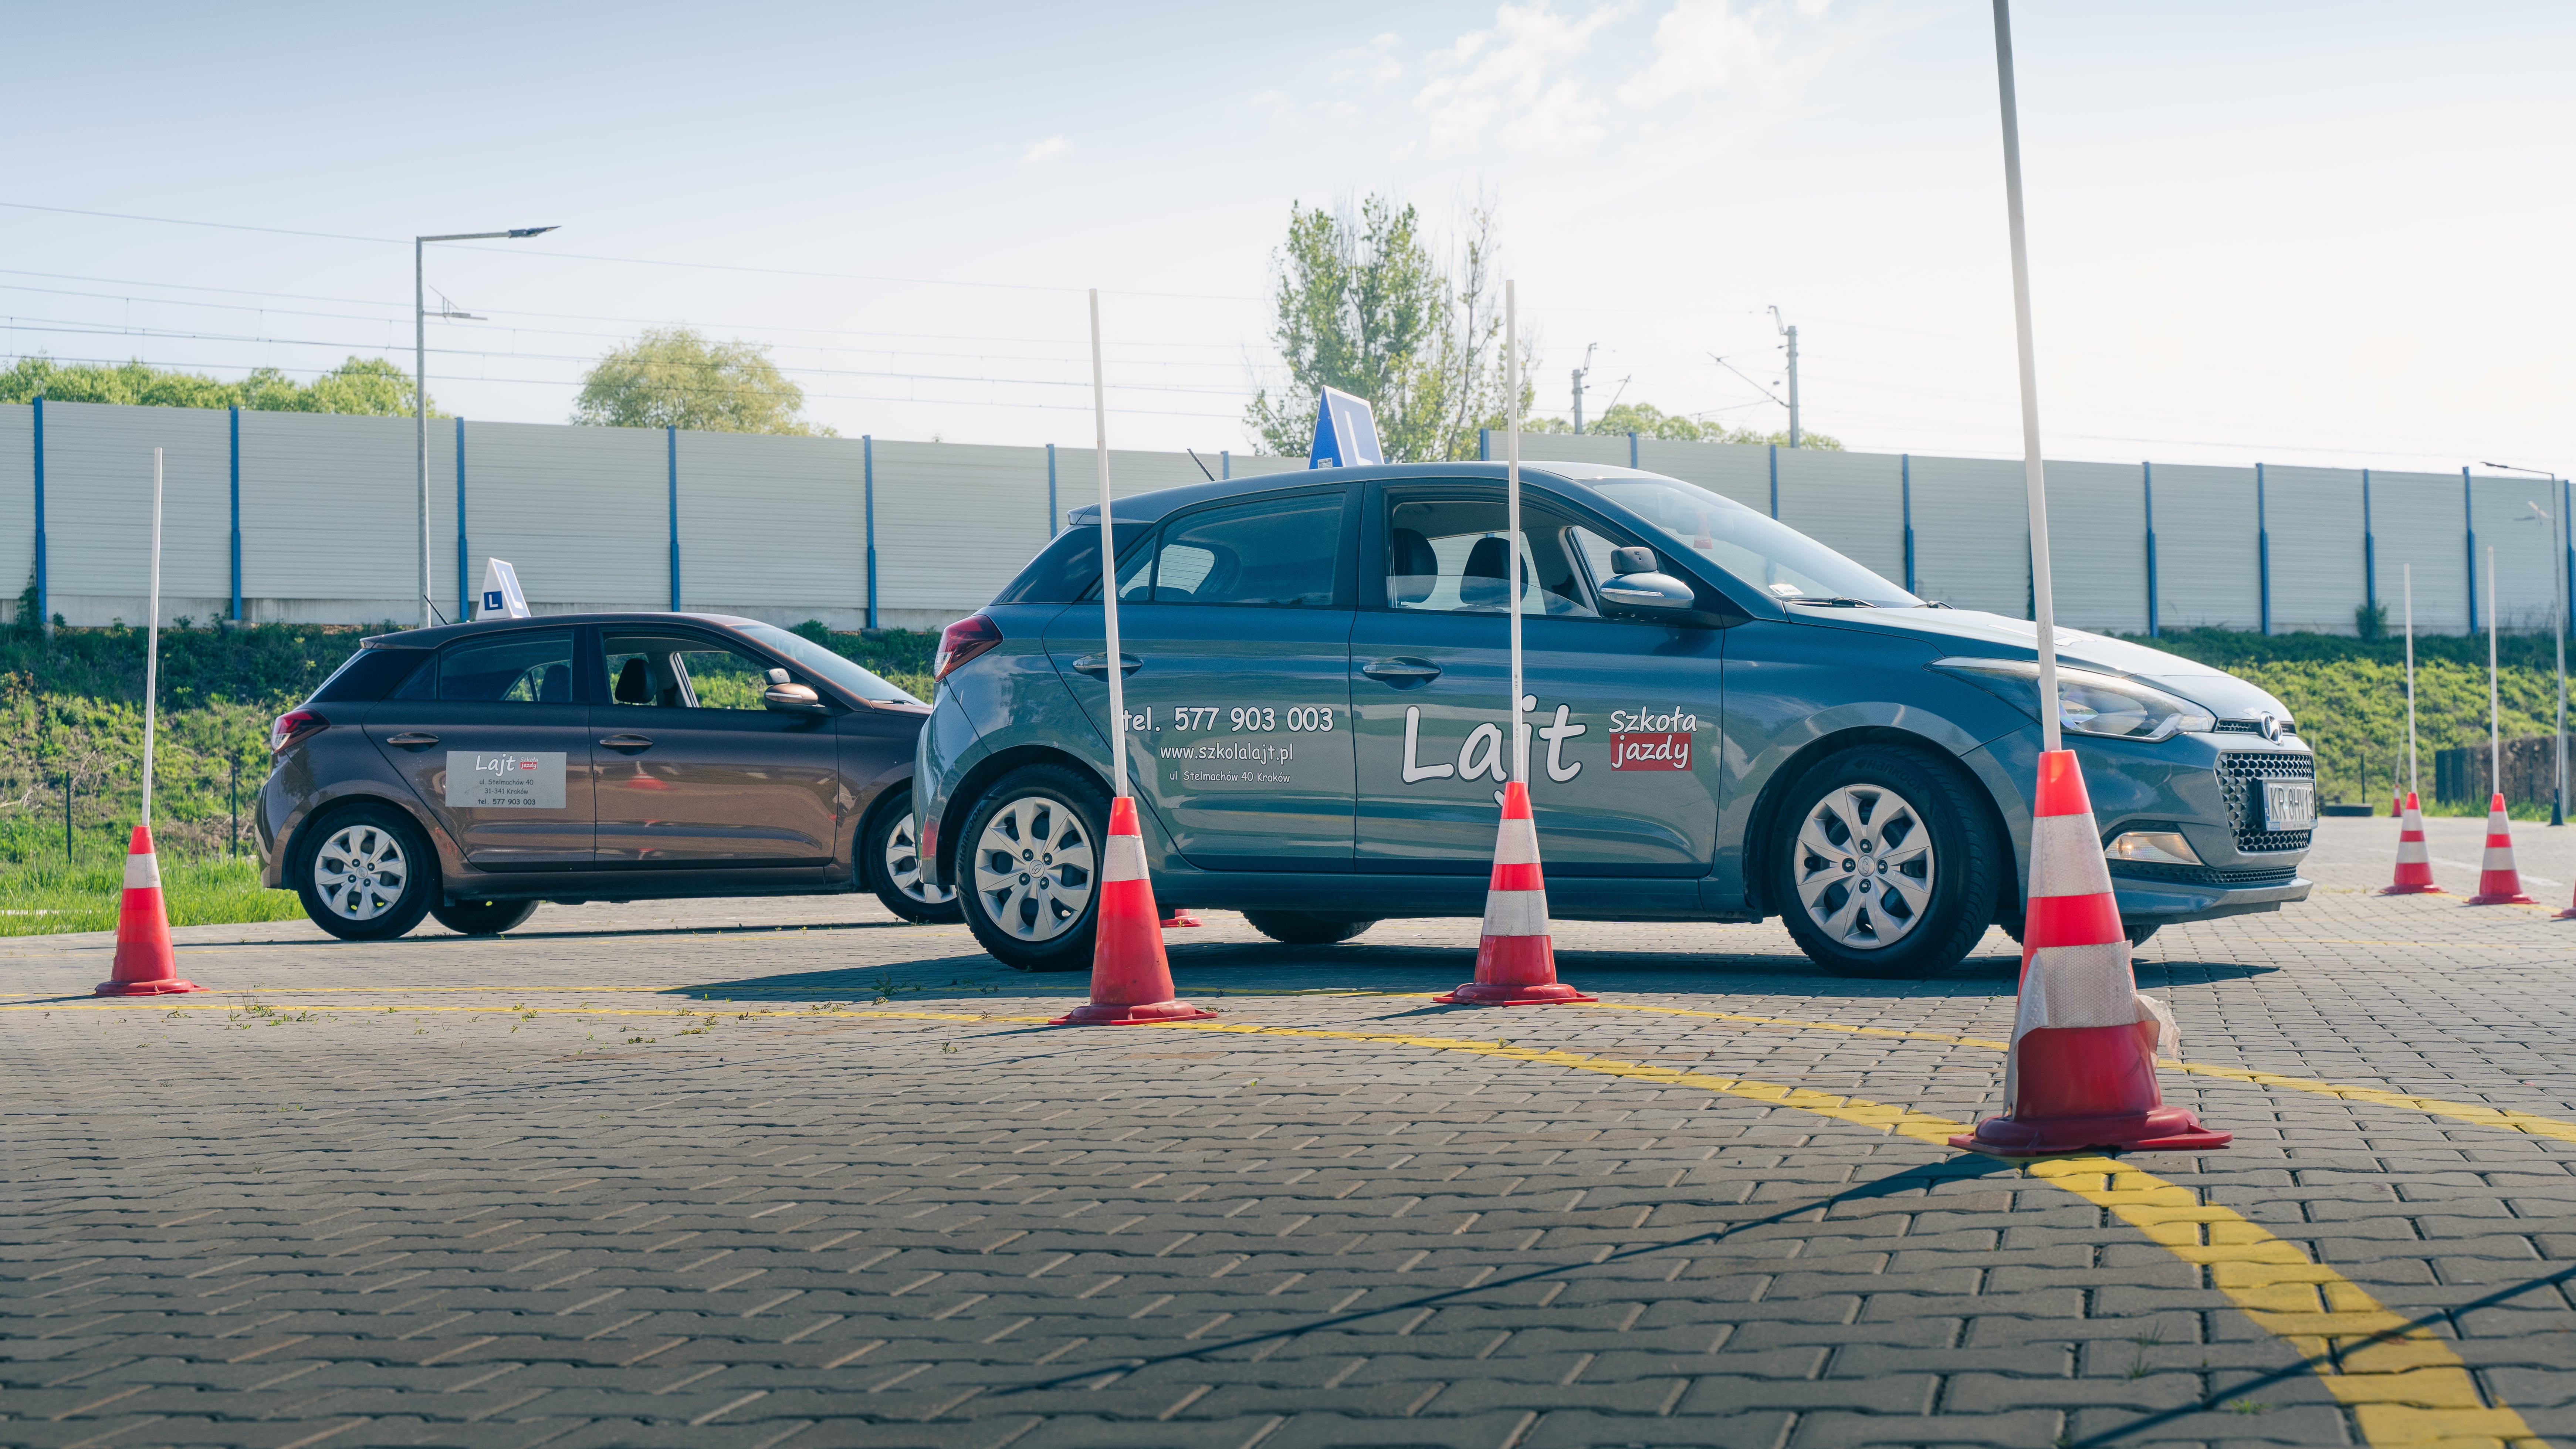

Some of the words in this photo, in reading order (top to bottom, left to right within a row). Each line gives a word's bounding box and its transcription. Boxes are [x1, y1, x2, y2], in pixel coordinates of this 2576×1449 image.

[489, 594, 498, 608] L
[501, 571, 523, 609] L
[1122, 707, 1160, 732] tel.
[1175, 707, 1219, 731] 577
[1231, 707, 1275, 731] 903
[1287, 707, 1333, 732] 003
[1609, 706, 1697, 733] Szkoła
[1160, 742, 1293, 765] www.szkolalajt.pl
[1612, 735, 1689, 769] jazdy
[475, 754, 516, 777] Lajt
[1170, 771, 1177, 781] ul
[1183, 771, 1238, 782] Stelmachów
[1241, 772, 1253, 782] 40
[1257, 772, 1290, 783] Kraków
[2270, 786, 2286, 819] KR
